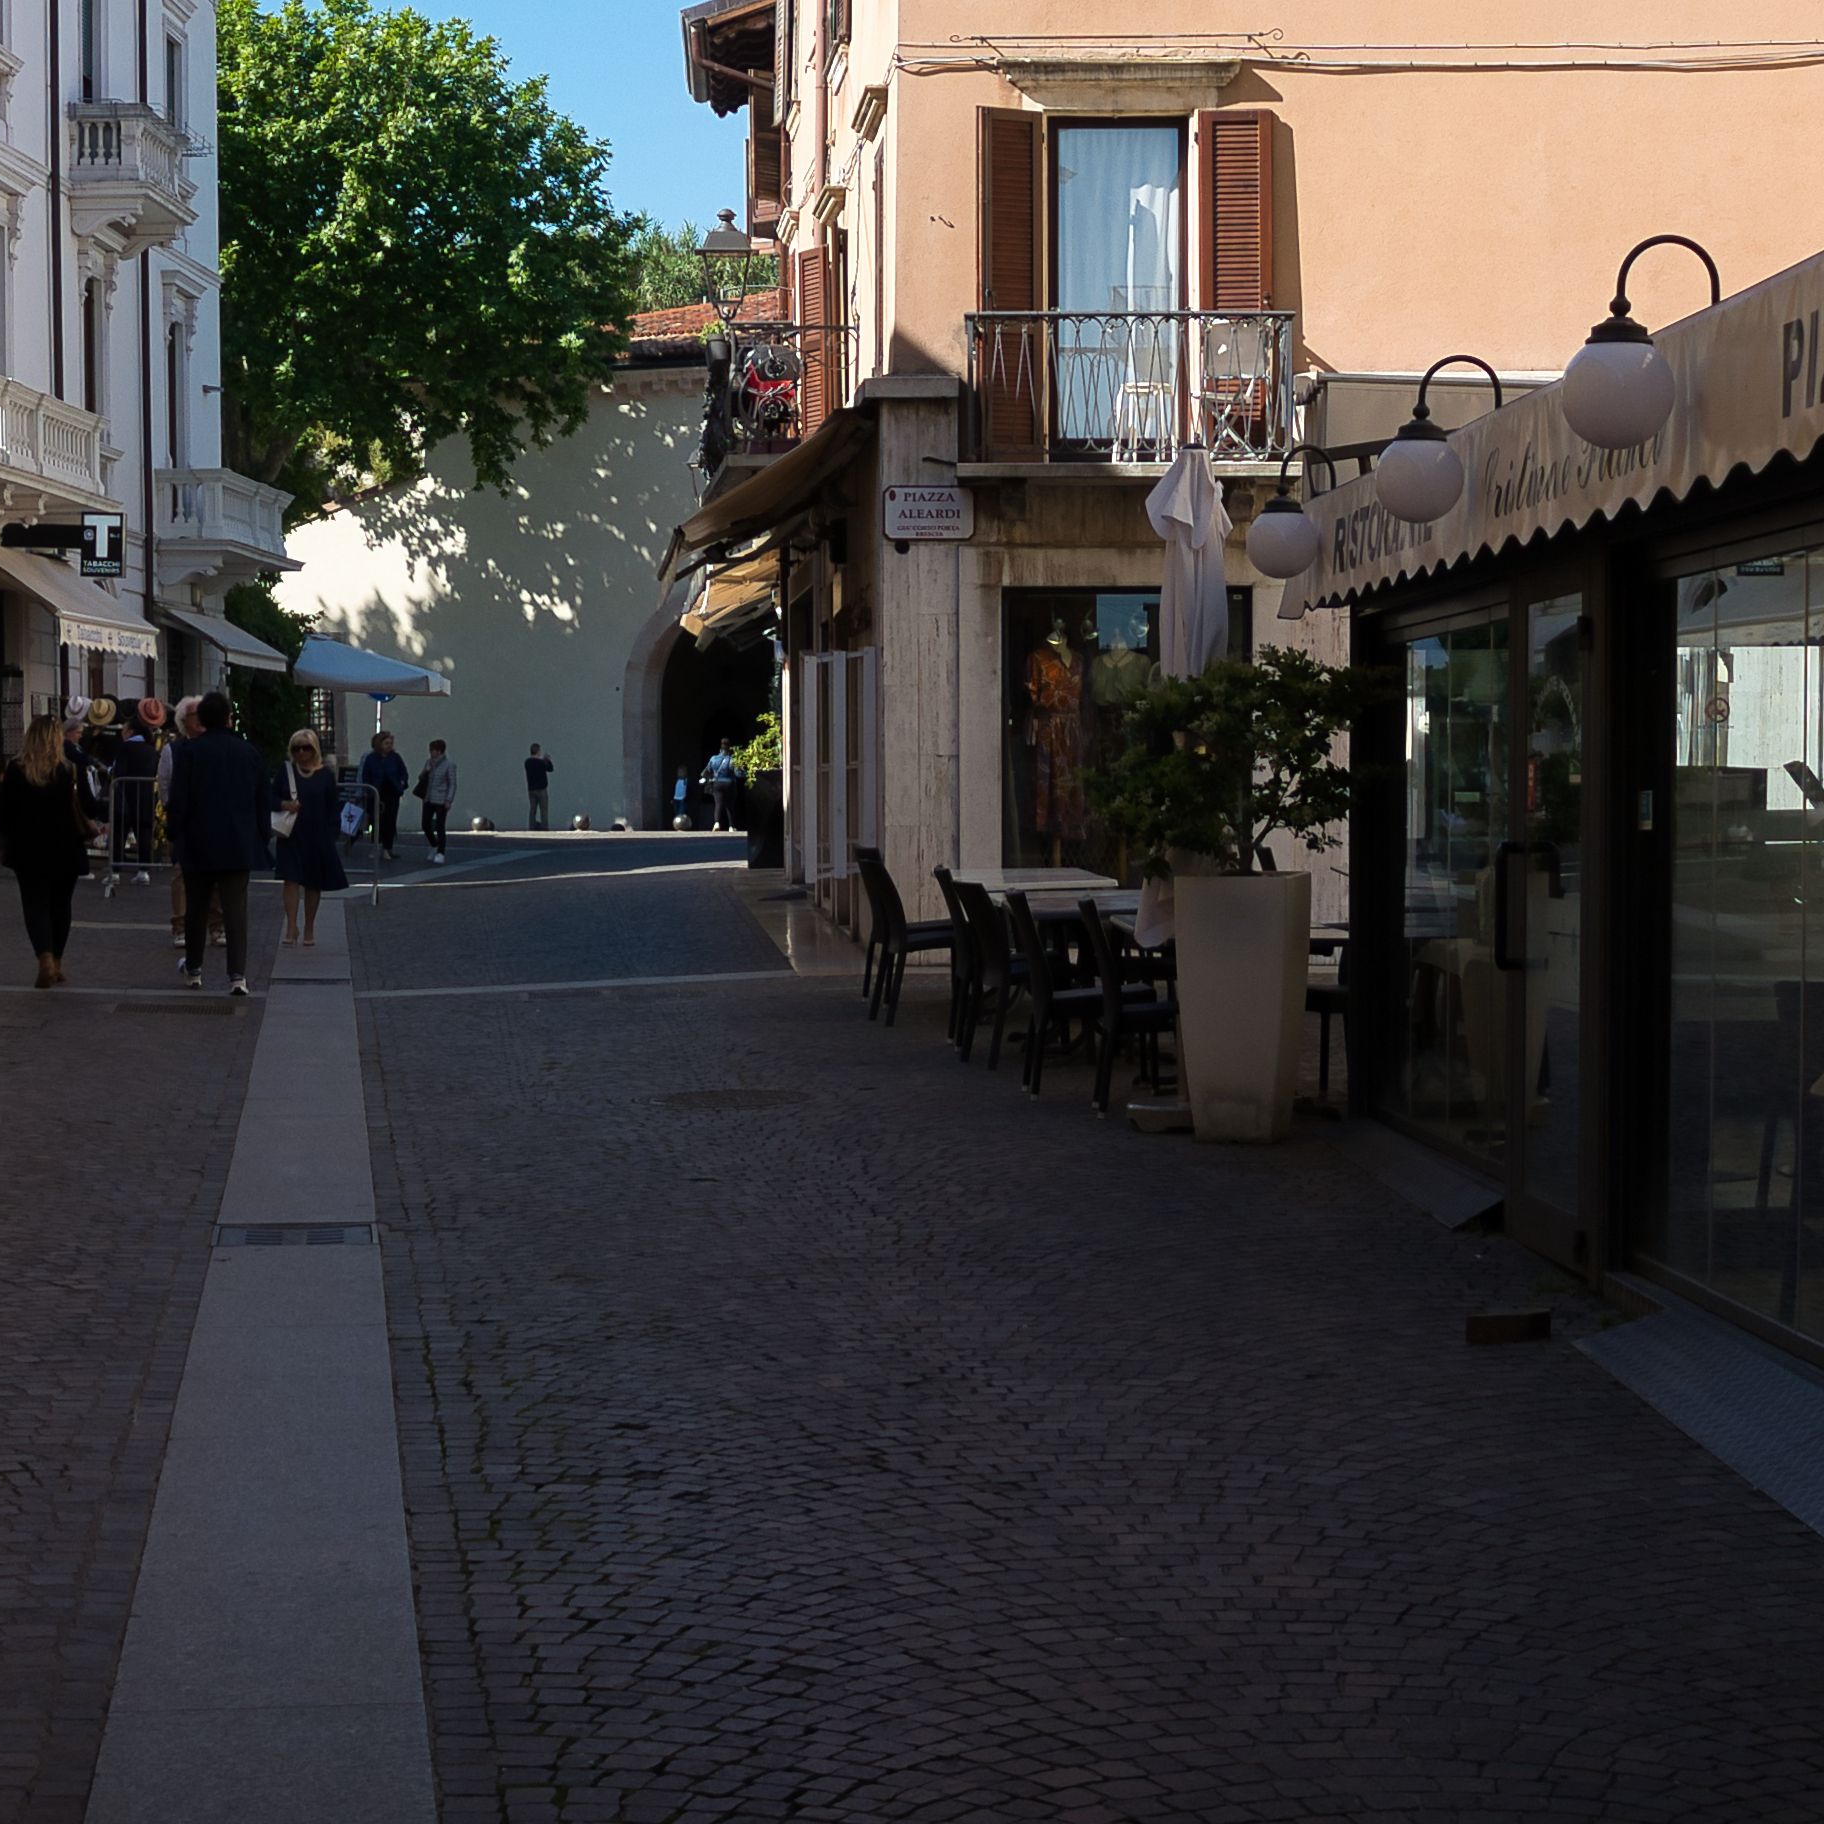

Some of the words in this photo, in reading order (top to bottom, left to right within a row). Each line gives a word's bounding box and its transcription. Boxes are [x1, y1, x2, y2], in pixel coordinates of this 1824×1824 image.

[903, 492, 956, 503] PIAZZA
[898, 509, 961, 520] ALEARDI
[84, 514, 121, 558] T
[83, 560, 121, 568] TABACCHI
